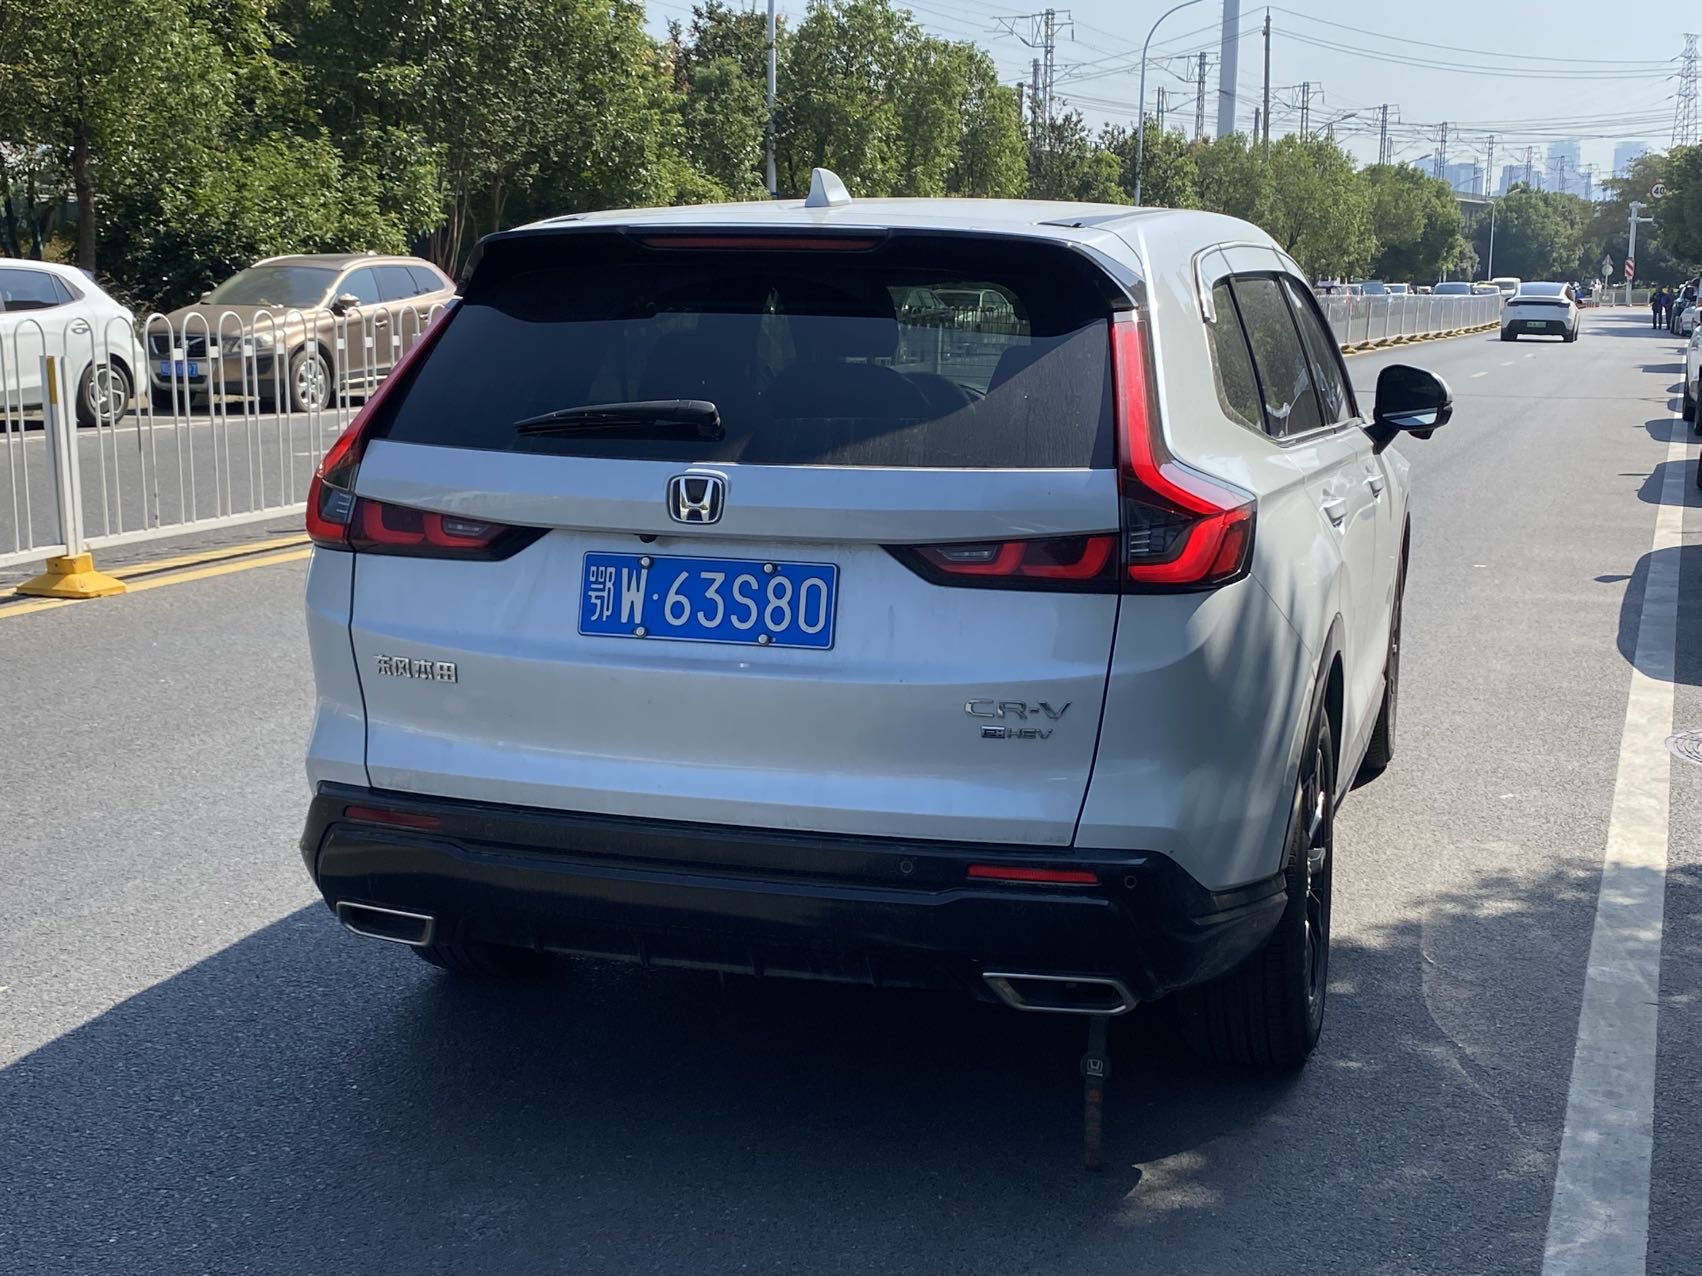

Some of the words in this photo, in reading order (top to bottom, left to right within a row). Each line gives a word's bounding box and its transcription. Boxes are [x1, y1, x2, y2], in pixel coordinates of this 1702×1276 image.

[373, 654, 458, 683] 东风本田
[964, 698, 1072, 720] CR-V
